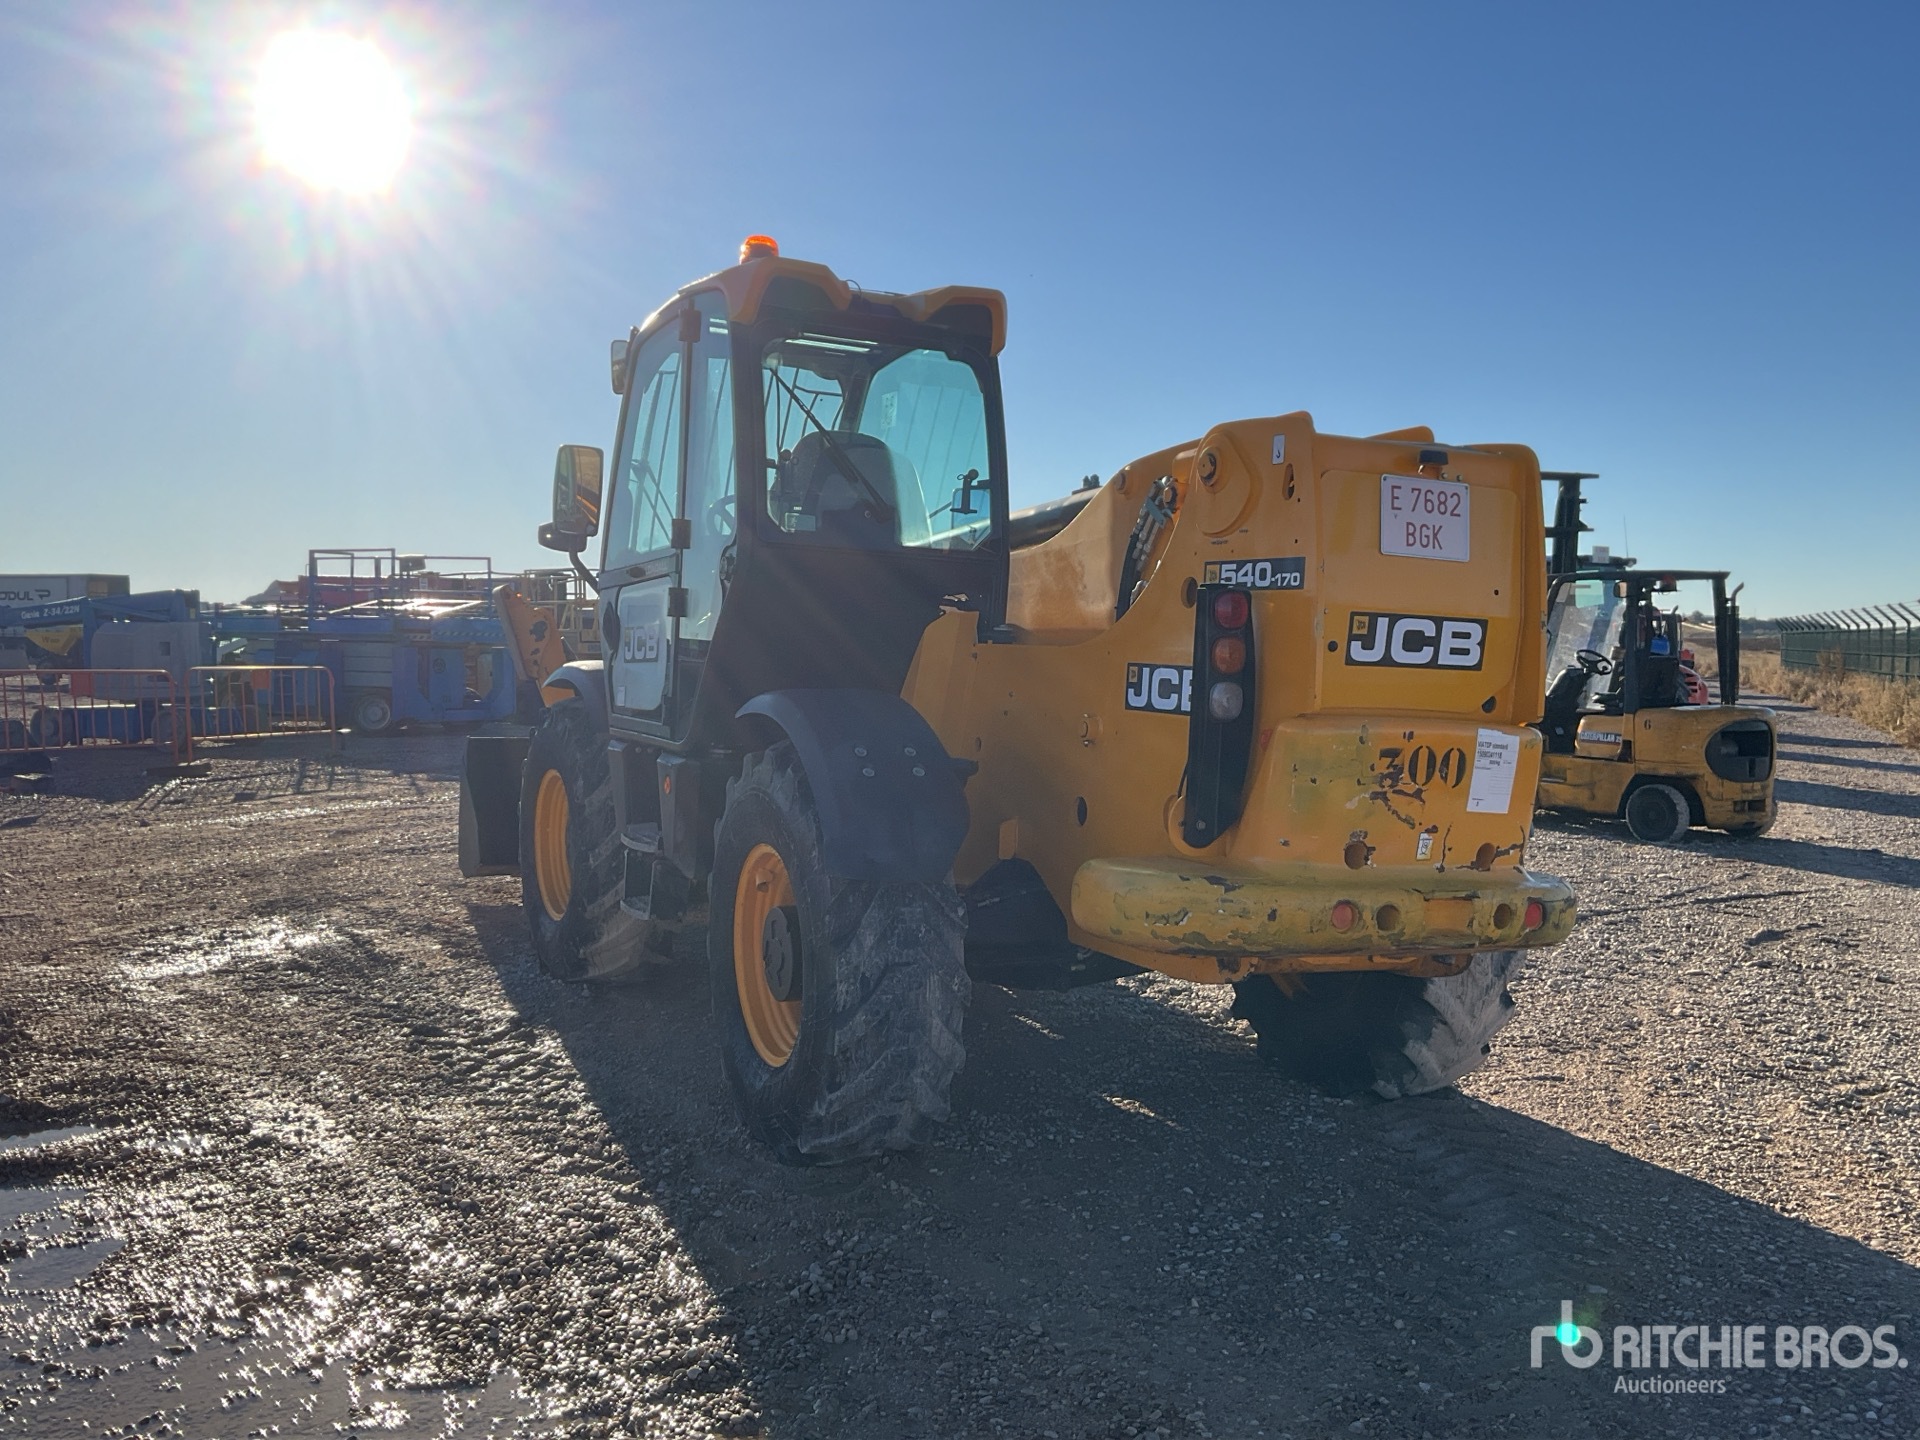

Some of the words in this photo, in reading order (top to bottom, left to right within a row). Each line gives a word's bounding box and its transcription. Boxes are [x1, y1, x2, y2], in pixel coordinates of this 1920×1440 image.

[1391, 485, 1402, 511] E
[1410, 487, 1461, 518] 7682
[1405, 521, 1443, 551] BGK
[625, 624, 659, 660] JCB
[1350, 616, 1482, 667] JCB
[1643, 719, 1652, 730] 6
